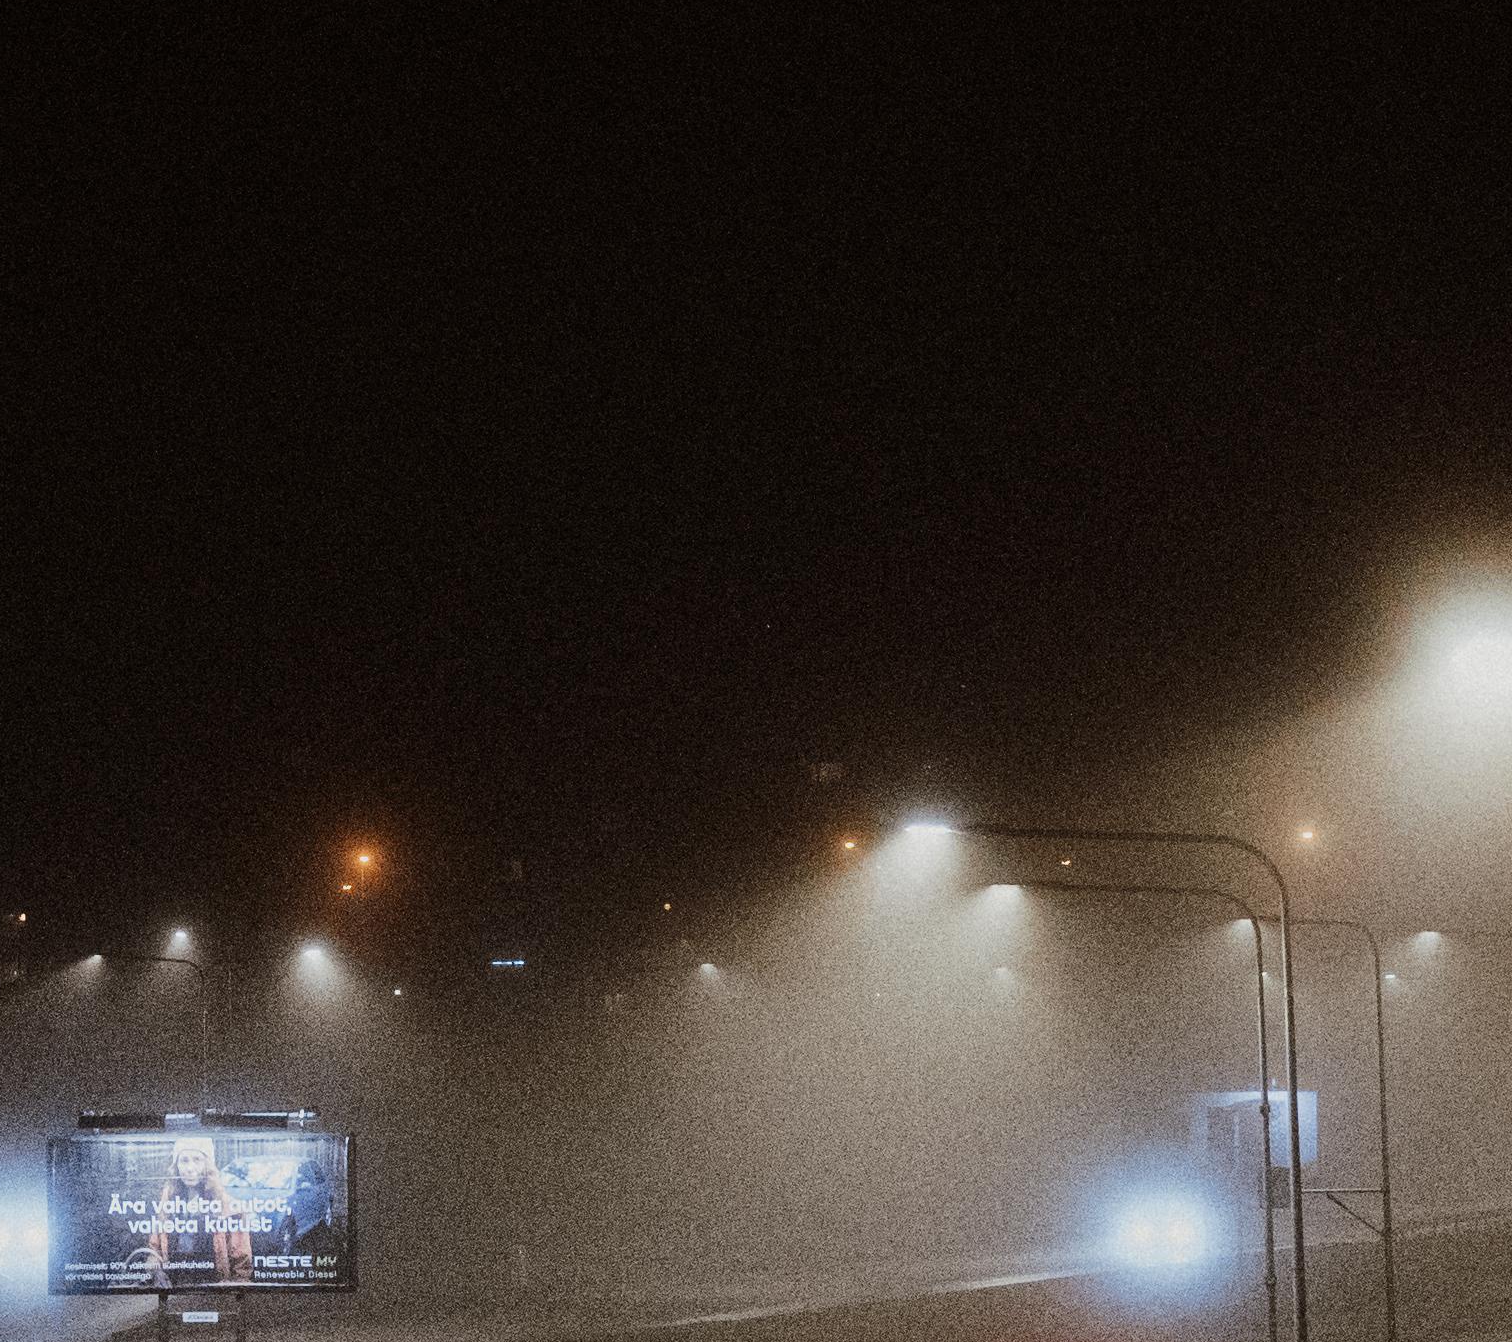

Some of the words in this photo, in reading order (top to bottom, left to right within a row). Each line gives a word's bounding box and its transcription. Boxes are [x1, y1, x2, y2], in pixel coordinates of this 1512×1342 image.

[108, 1194, 146, 1214] Ära
[152, 1196, 222, 1214] vaheta
[229, 1197, 292, 1215] autot,
[128, 1216, 198, 1234] vaheta
[205, 1215, 273, 1233] kütust
[254, 1255, 313, 1267] NESTE
[316, 1256, 337, 1266] MY
[254, 1270, 305, 1279] Renewable
[308, 1270, 337, 1279] Diesel
